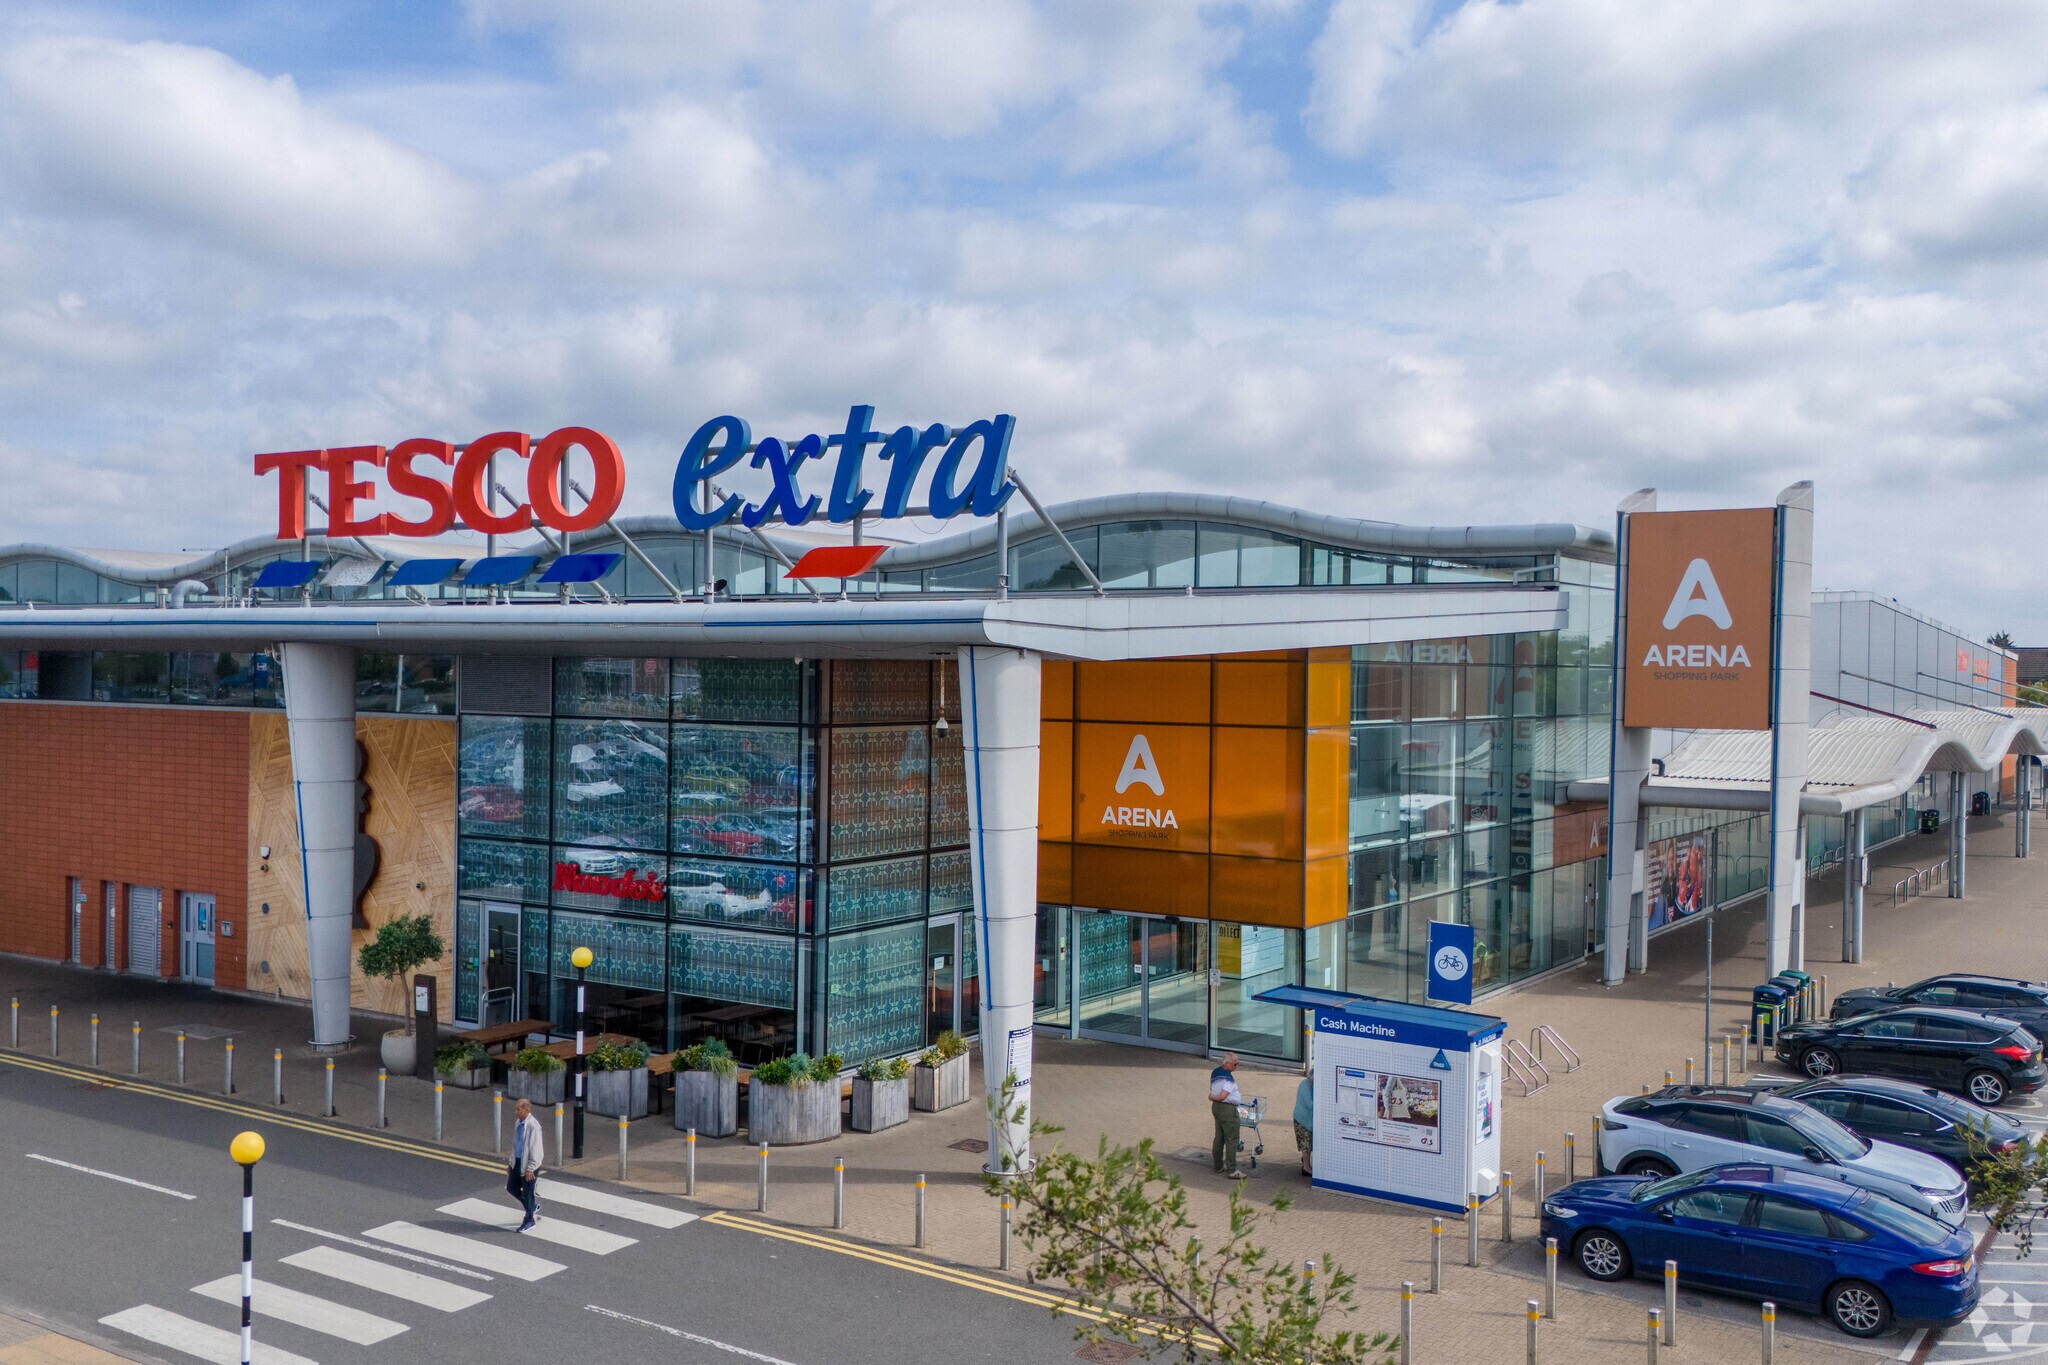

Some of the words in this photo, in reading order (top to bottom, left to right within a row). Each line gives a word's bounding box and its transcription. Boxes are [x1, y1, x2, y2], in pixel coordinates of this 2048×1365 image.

[254, 426, 625, 539] TESCO
[673, 404, 1017, 530] extra
[1643, 644, 1751, 667] ARENA
[1653, 672, 1707, 681] SHOPPING
[1710, 672, 1739, 681] PARK
[1101, 805, 1178, 829] ARENA
[1108, 829, 1147, 839] SHOPPING
[1148, 831, 1170, 840] PARK
[552, 861, 665, 902] Nando's
[1218, 926, 1240, 938] OLLECT
[1320, 1017, 1347, 1030] Cash
[1350, 1021, 1396, 1037] Machine
